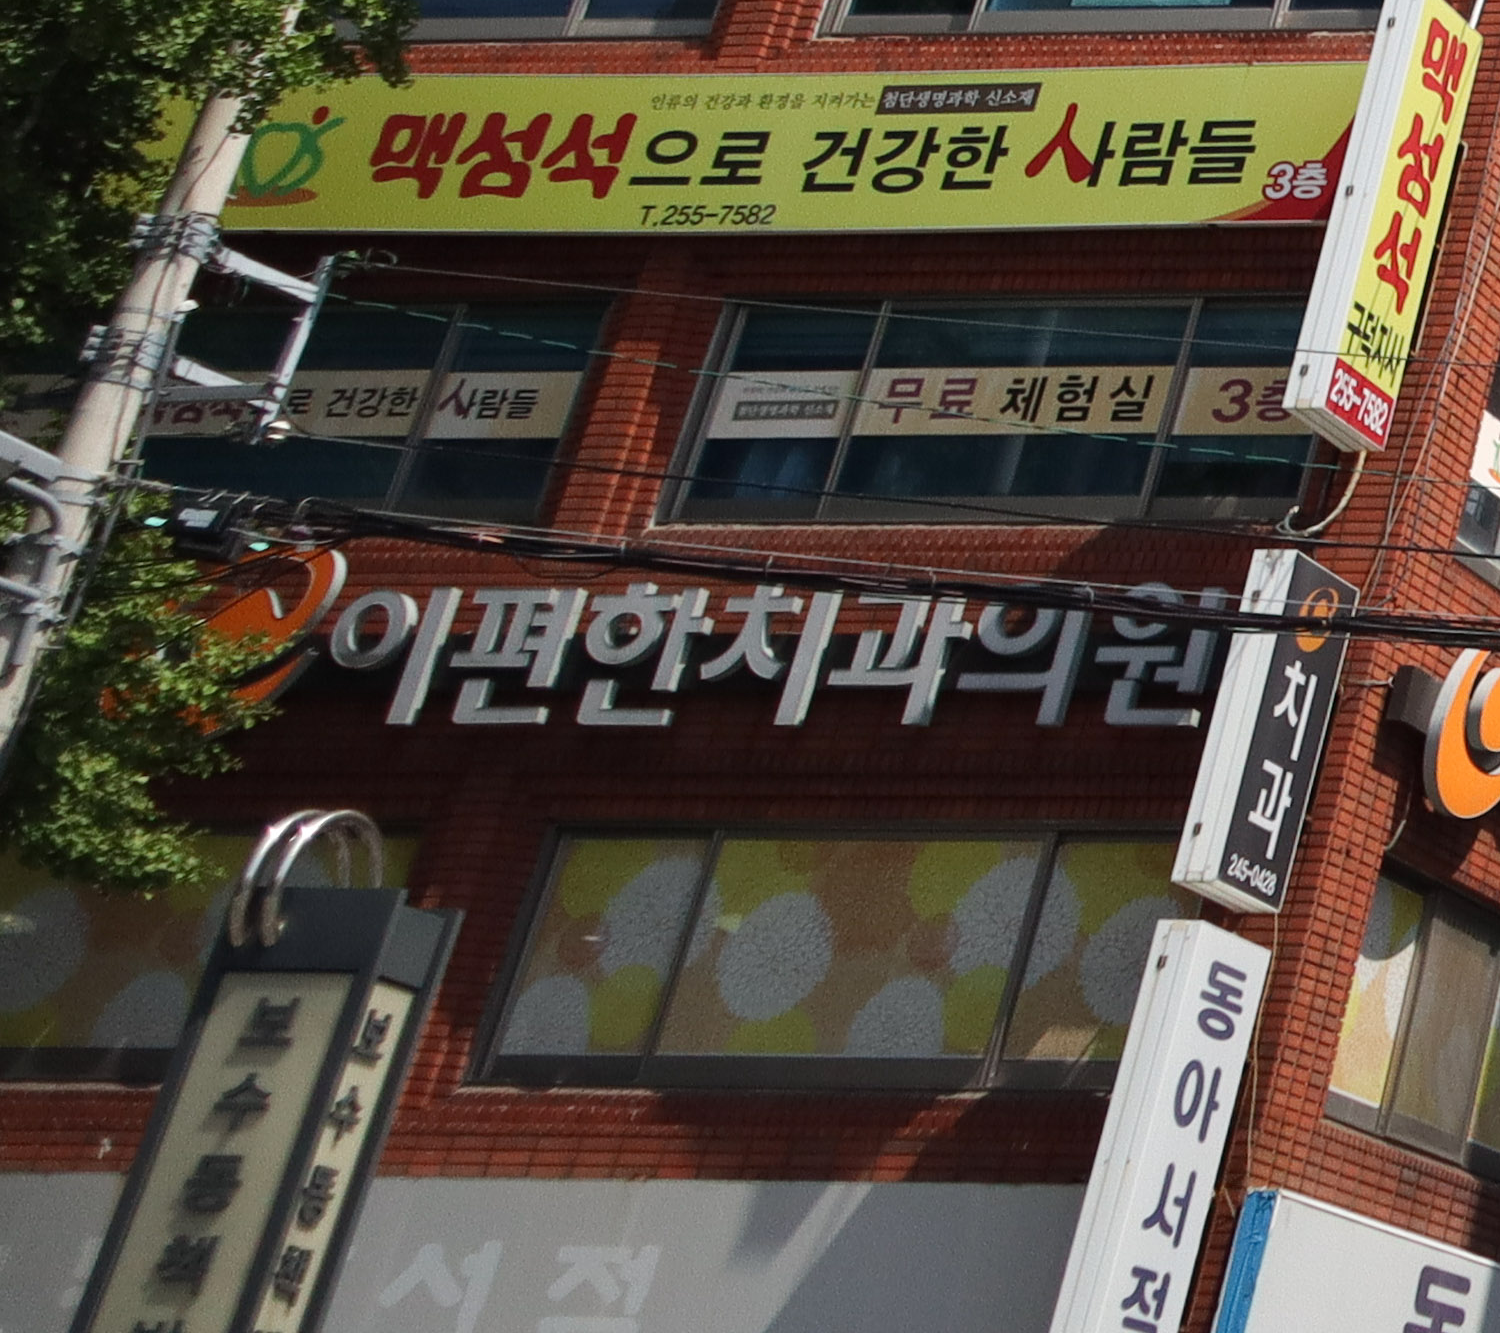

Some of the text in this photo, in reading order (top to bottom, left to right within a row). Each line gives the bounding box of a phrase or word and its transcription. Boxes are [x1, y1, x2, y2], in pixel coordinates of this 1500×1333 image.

[650, 93, 699, 110] 인류의
[703, 93, 754, 111] 건강과
[985, 88, 1036, 108] 신소재
[800, 124, 1011, 194] 건강한
[1024, 101, 1257, 188] 사람들
[1263, 160, 1329, 201] 3층
[640, 204, 777, 227] T.255-7582
[326, 386, 418, 419] 건강한
[438, 378, 540, 421] 사람들
[874, 377, 980, 425] 무료
[1000, 374, 1155, 424] 체험실
[1329, 368, 1389, 436] 255-7582
[330, 580, 1230, 727] 이편한치과의원
[1248, 660, 1318, 861] 치과
[1226, 852, 1278, 897] 245-0428
[1120, 959, 1248, 1333] 동아서적
